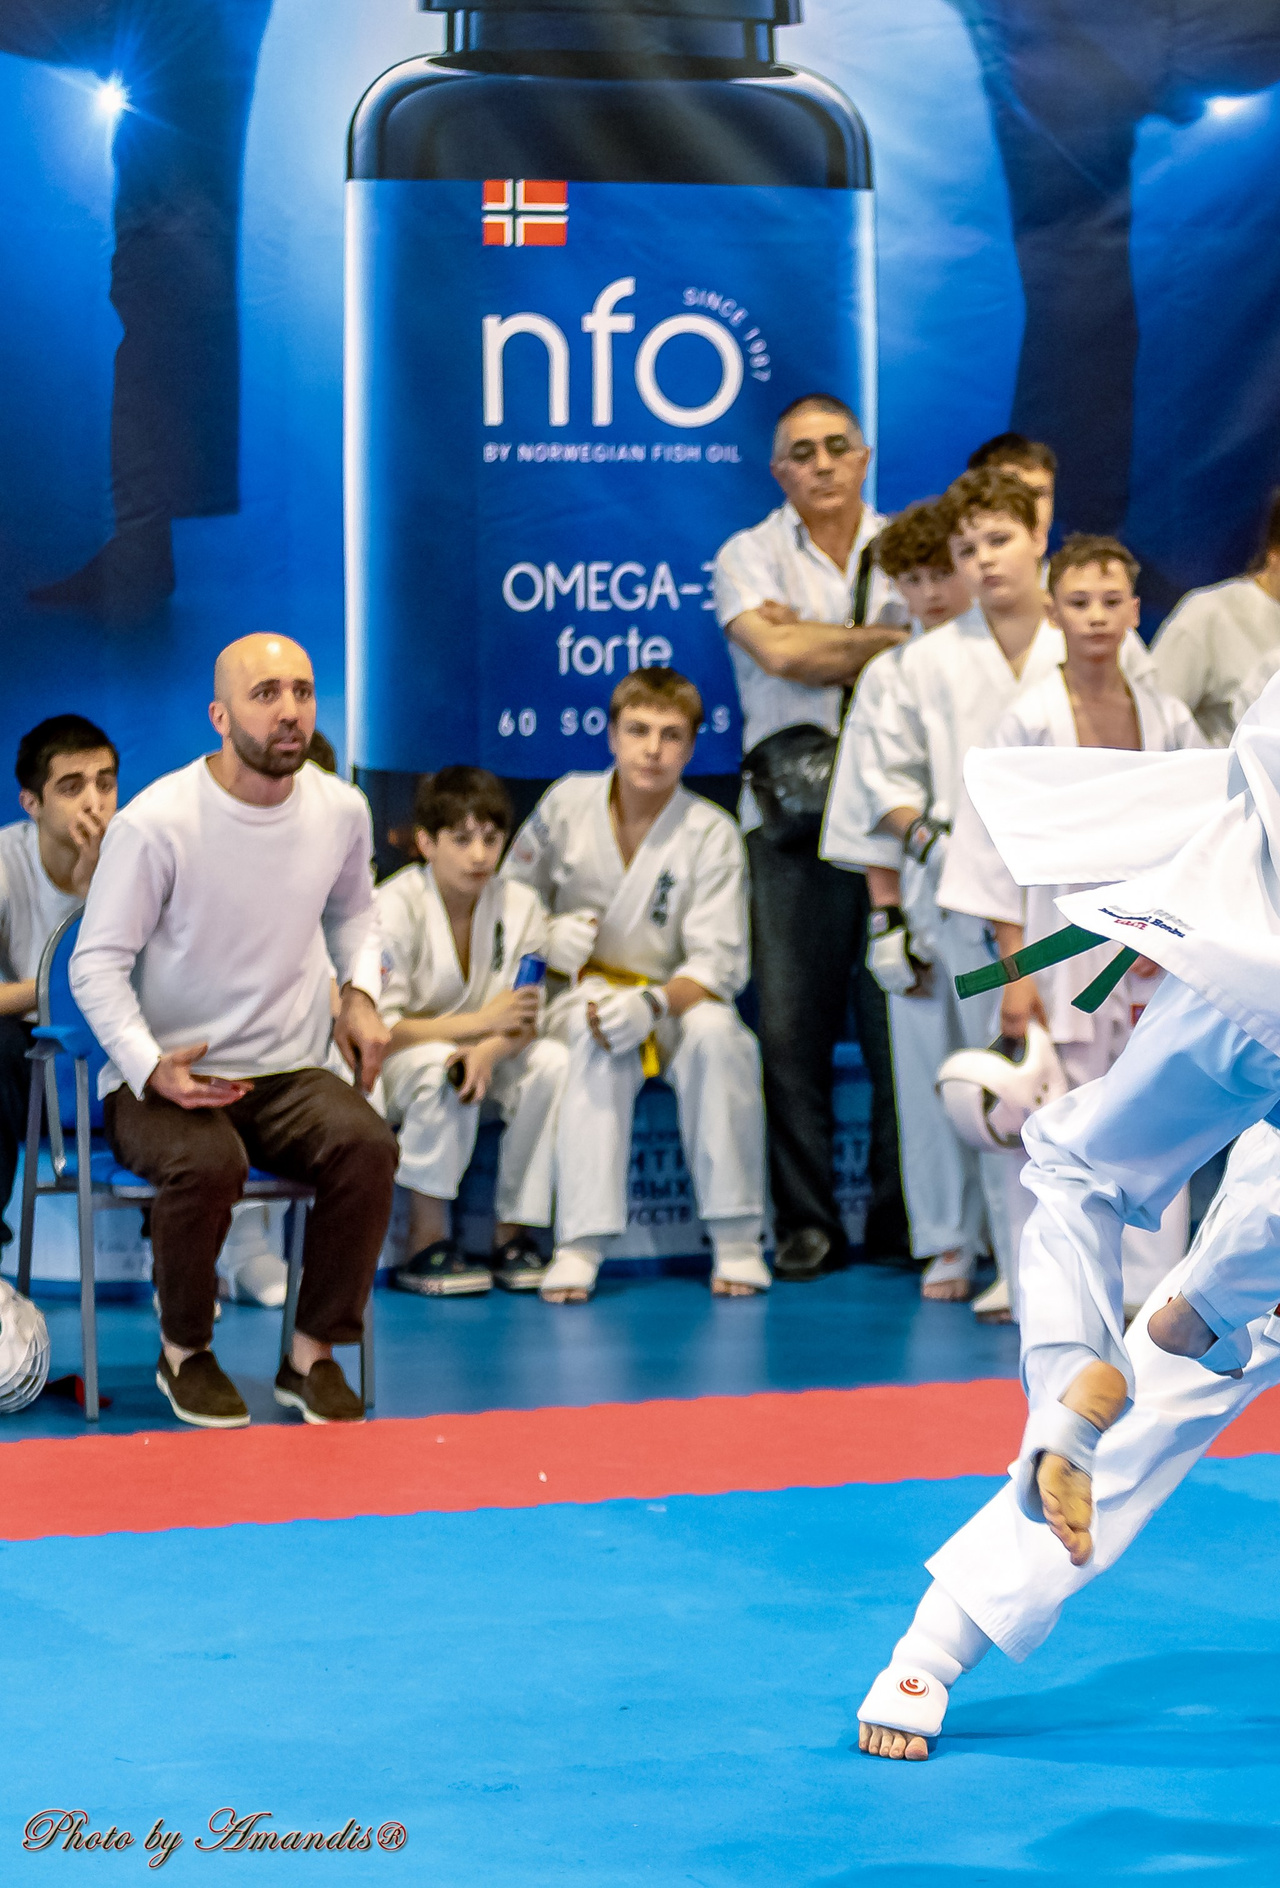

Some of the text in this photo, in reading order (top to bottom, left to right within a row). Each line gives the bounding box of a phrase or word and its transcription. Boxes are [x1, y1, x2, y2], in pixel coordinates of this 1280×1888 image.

[683, 287, 749, 328] SINCE
[482, 276, 744, 428] nfo
[483, 442, 742, 463] BY NORWEGIAN FISH OIL
[557, 624, 673, 676] forte
[498, 707, 538, 737] 60
